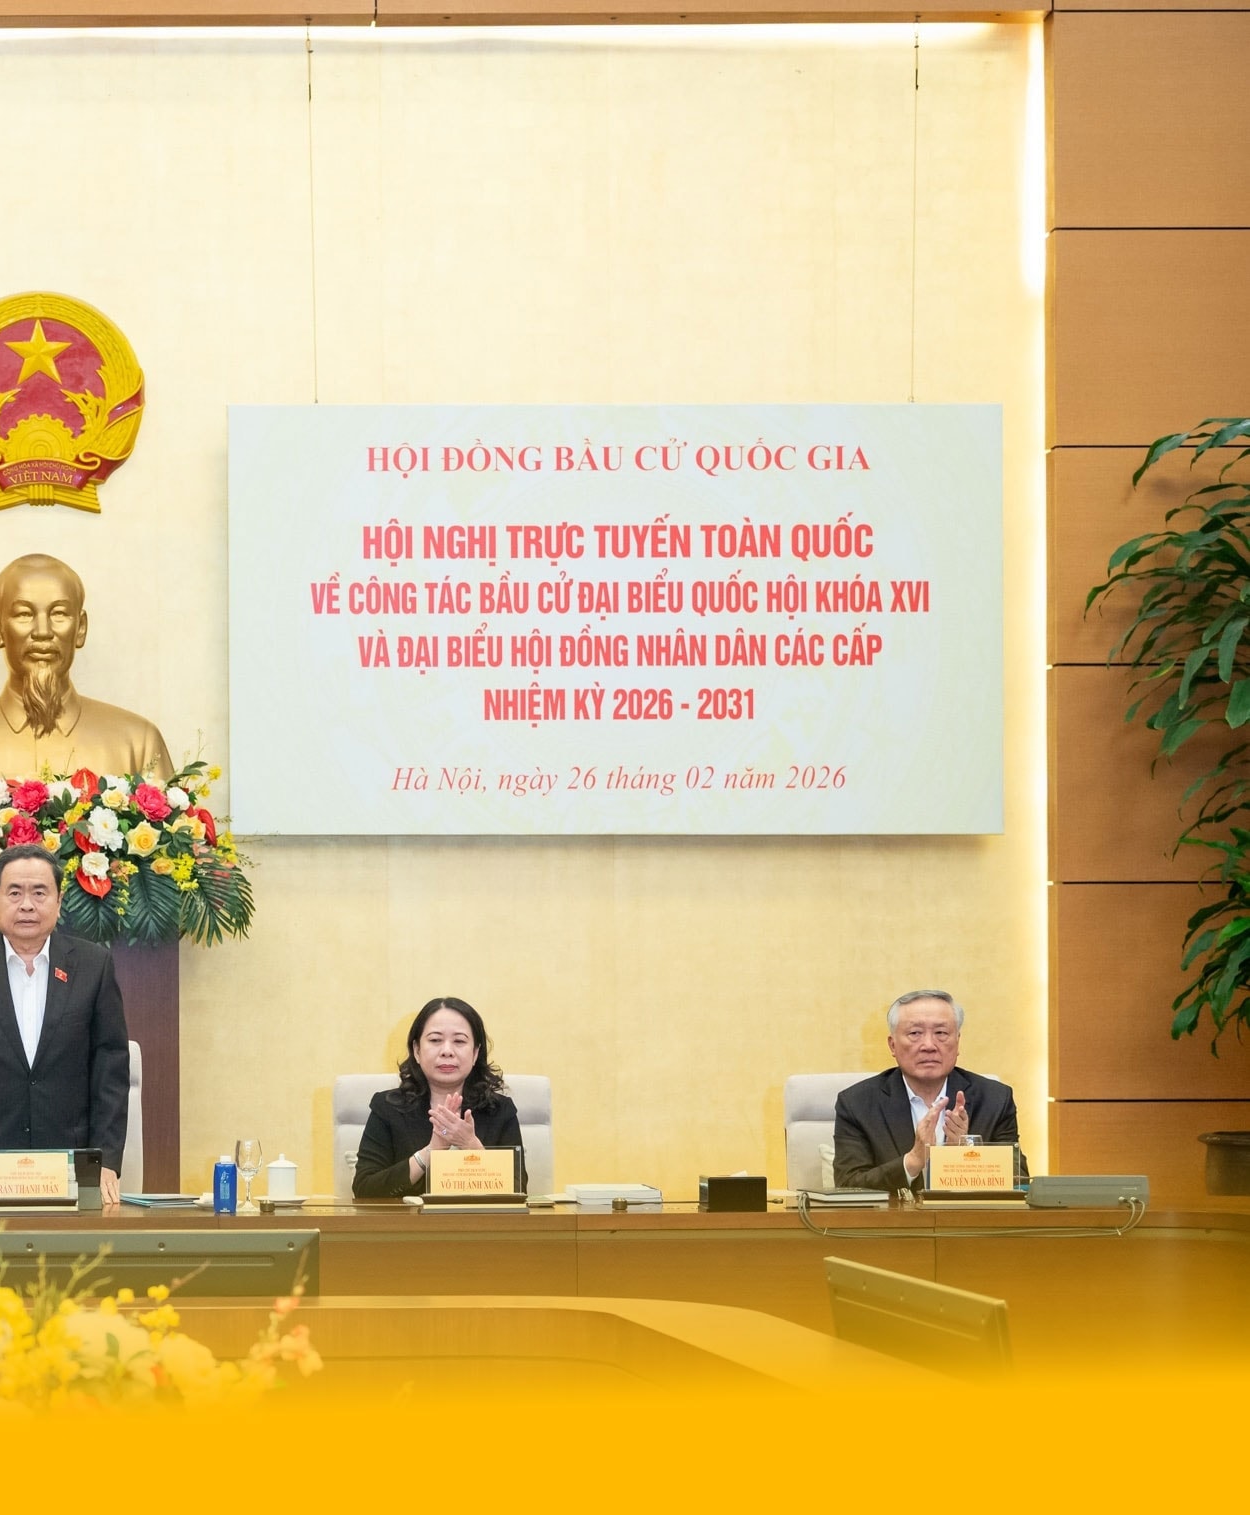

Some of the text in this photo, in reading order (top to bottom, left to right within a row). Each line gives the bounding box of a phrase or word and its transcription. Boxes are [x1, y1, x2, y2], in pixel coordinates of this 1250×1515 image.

[41, 471, 73, 484] NAM
[366, 437, 871, 479] HỘI ĐỒNG BẦU CỬ QUỐC GIA
[362, 512, 874, 567] HỘI NGHỊ TRỰC TUYẾN TOÀN QUỐC
[310, 568, 930, 621] VỀ CÔNG TÁC BẦU CỬ ĐẠI BIỂU QUỐC HỘI KHÓA XVI
[357, 622, 883, 676] VÀ ĐẠI BIỂU HỘI ĐỒNG NHÂN DÂN CÁC CẤP
[483, 681, 567, 729] NHIỆM
[573, 681, 606, 721] KỲ
[612, 688, 674, 721] 2026
[696, 688, 755, 721] 2031
[391, 765, 847, 797] Hà Nội, ngày 26 tháng 02 năm 2026
[13, 1184, 41, 1194] THANH
